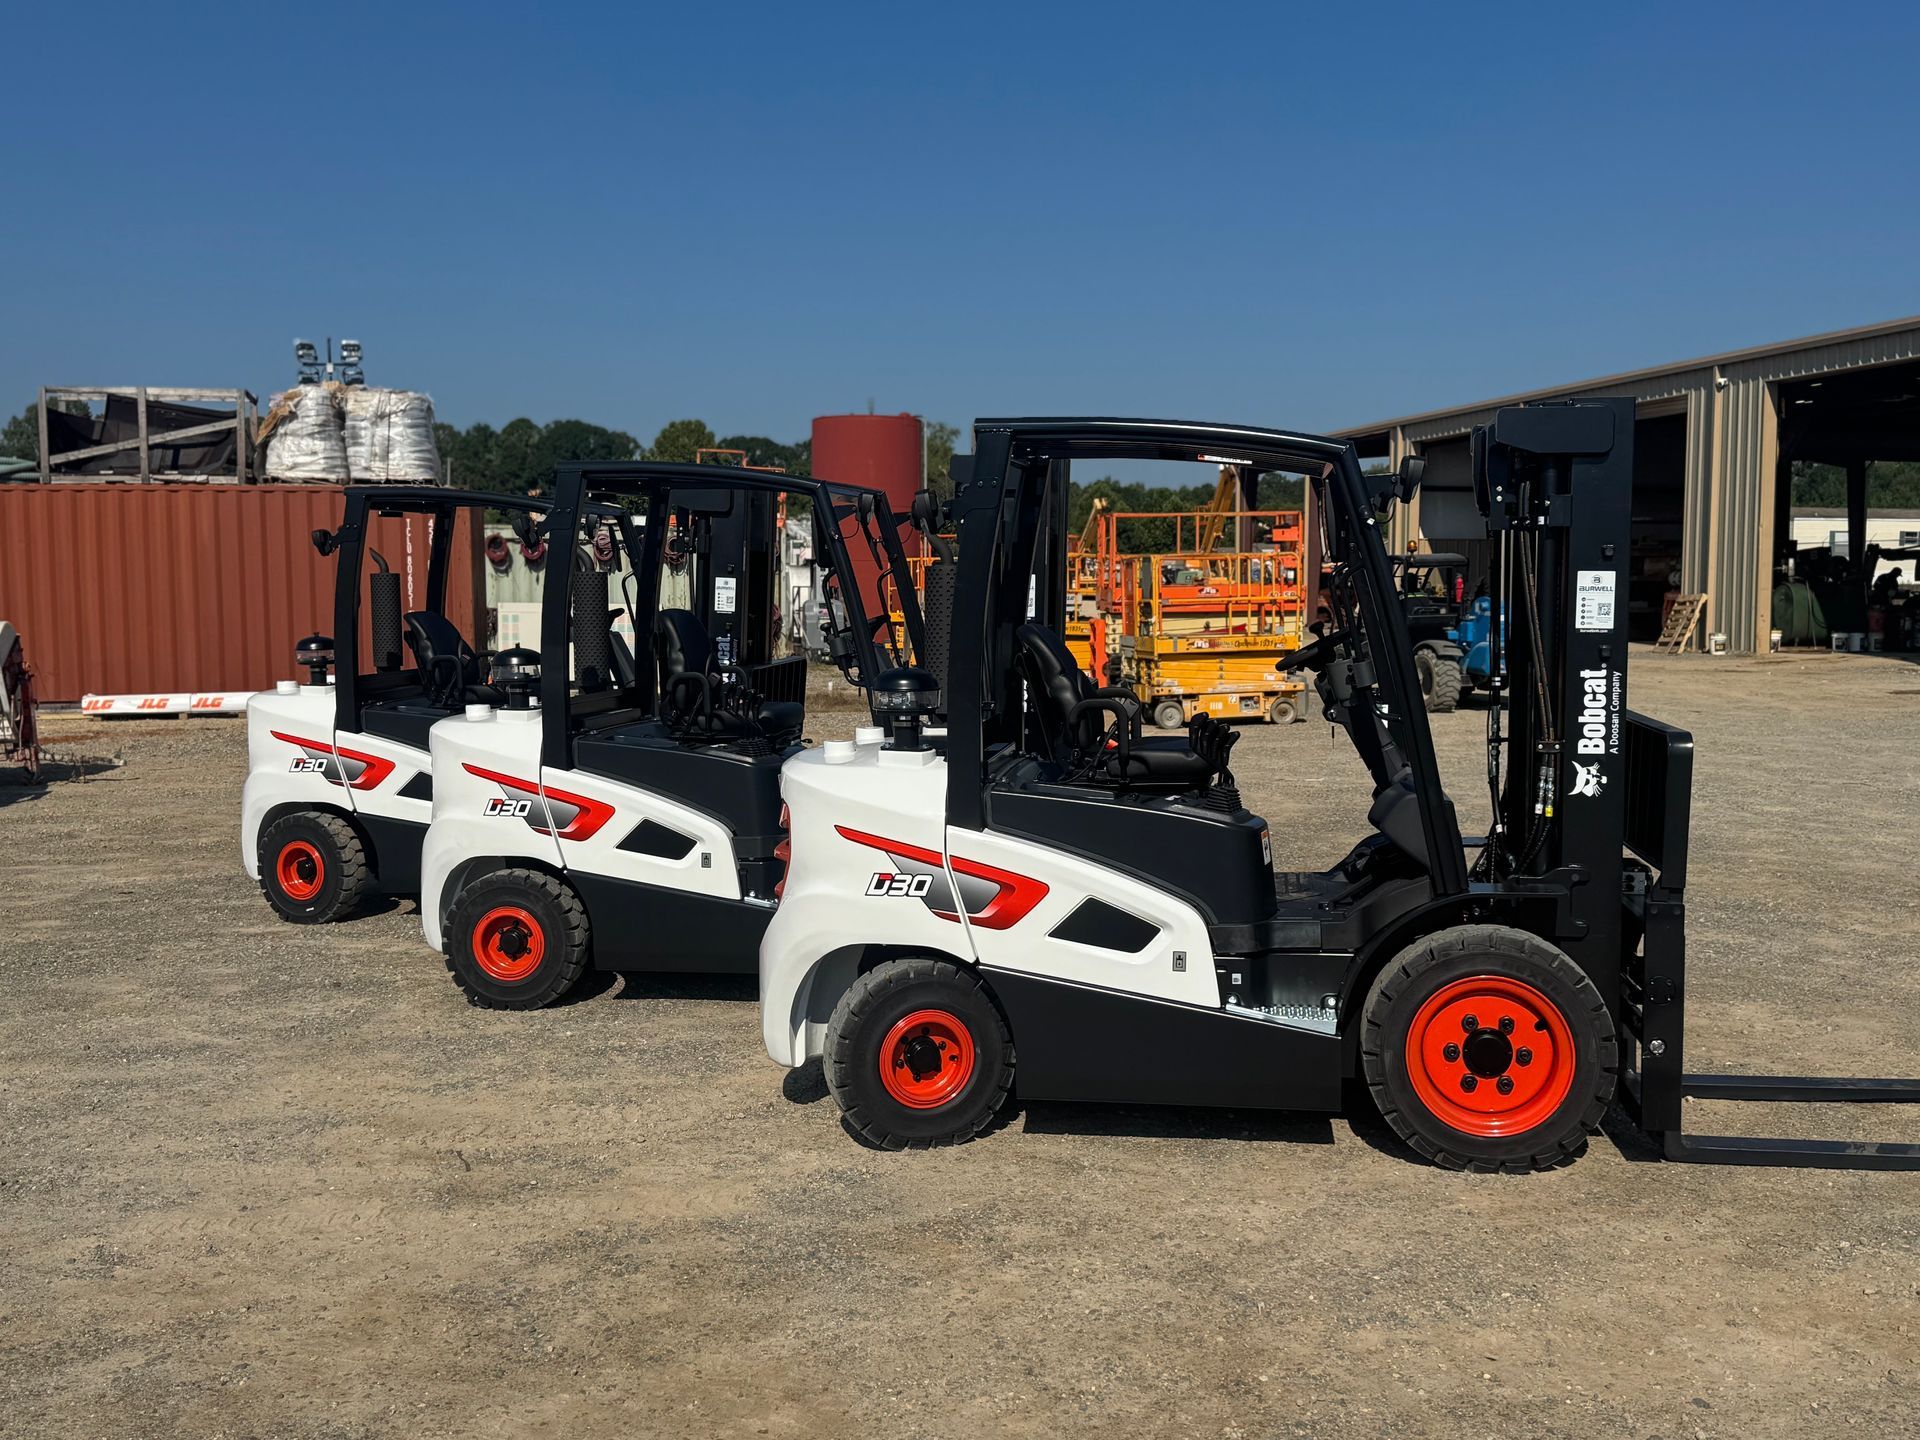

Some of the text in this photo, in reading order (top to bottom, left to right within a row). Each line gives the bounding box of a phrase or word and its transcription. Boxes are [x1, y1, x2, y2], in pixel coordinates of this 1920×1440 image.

[1610, 671, 1622, 711] Company
[83, 700, 115, 710] JLG
[137, 698, 170, 709] JLG
[192, 697, 224, 708] JLG
[1609, 713, 1620, 745] Doosan
[289, 758, 328, 772] D30
[483, 799, 533, 817] D30
[865, 873, 934, 897] D30
